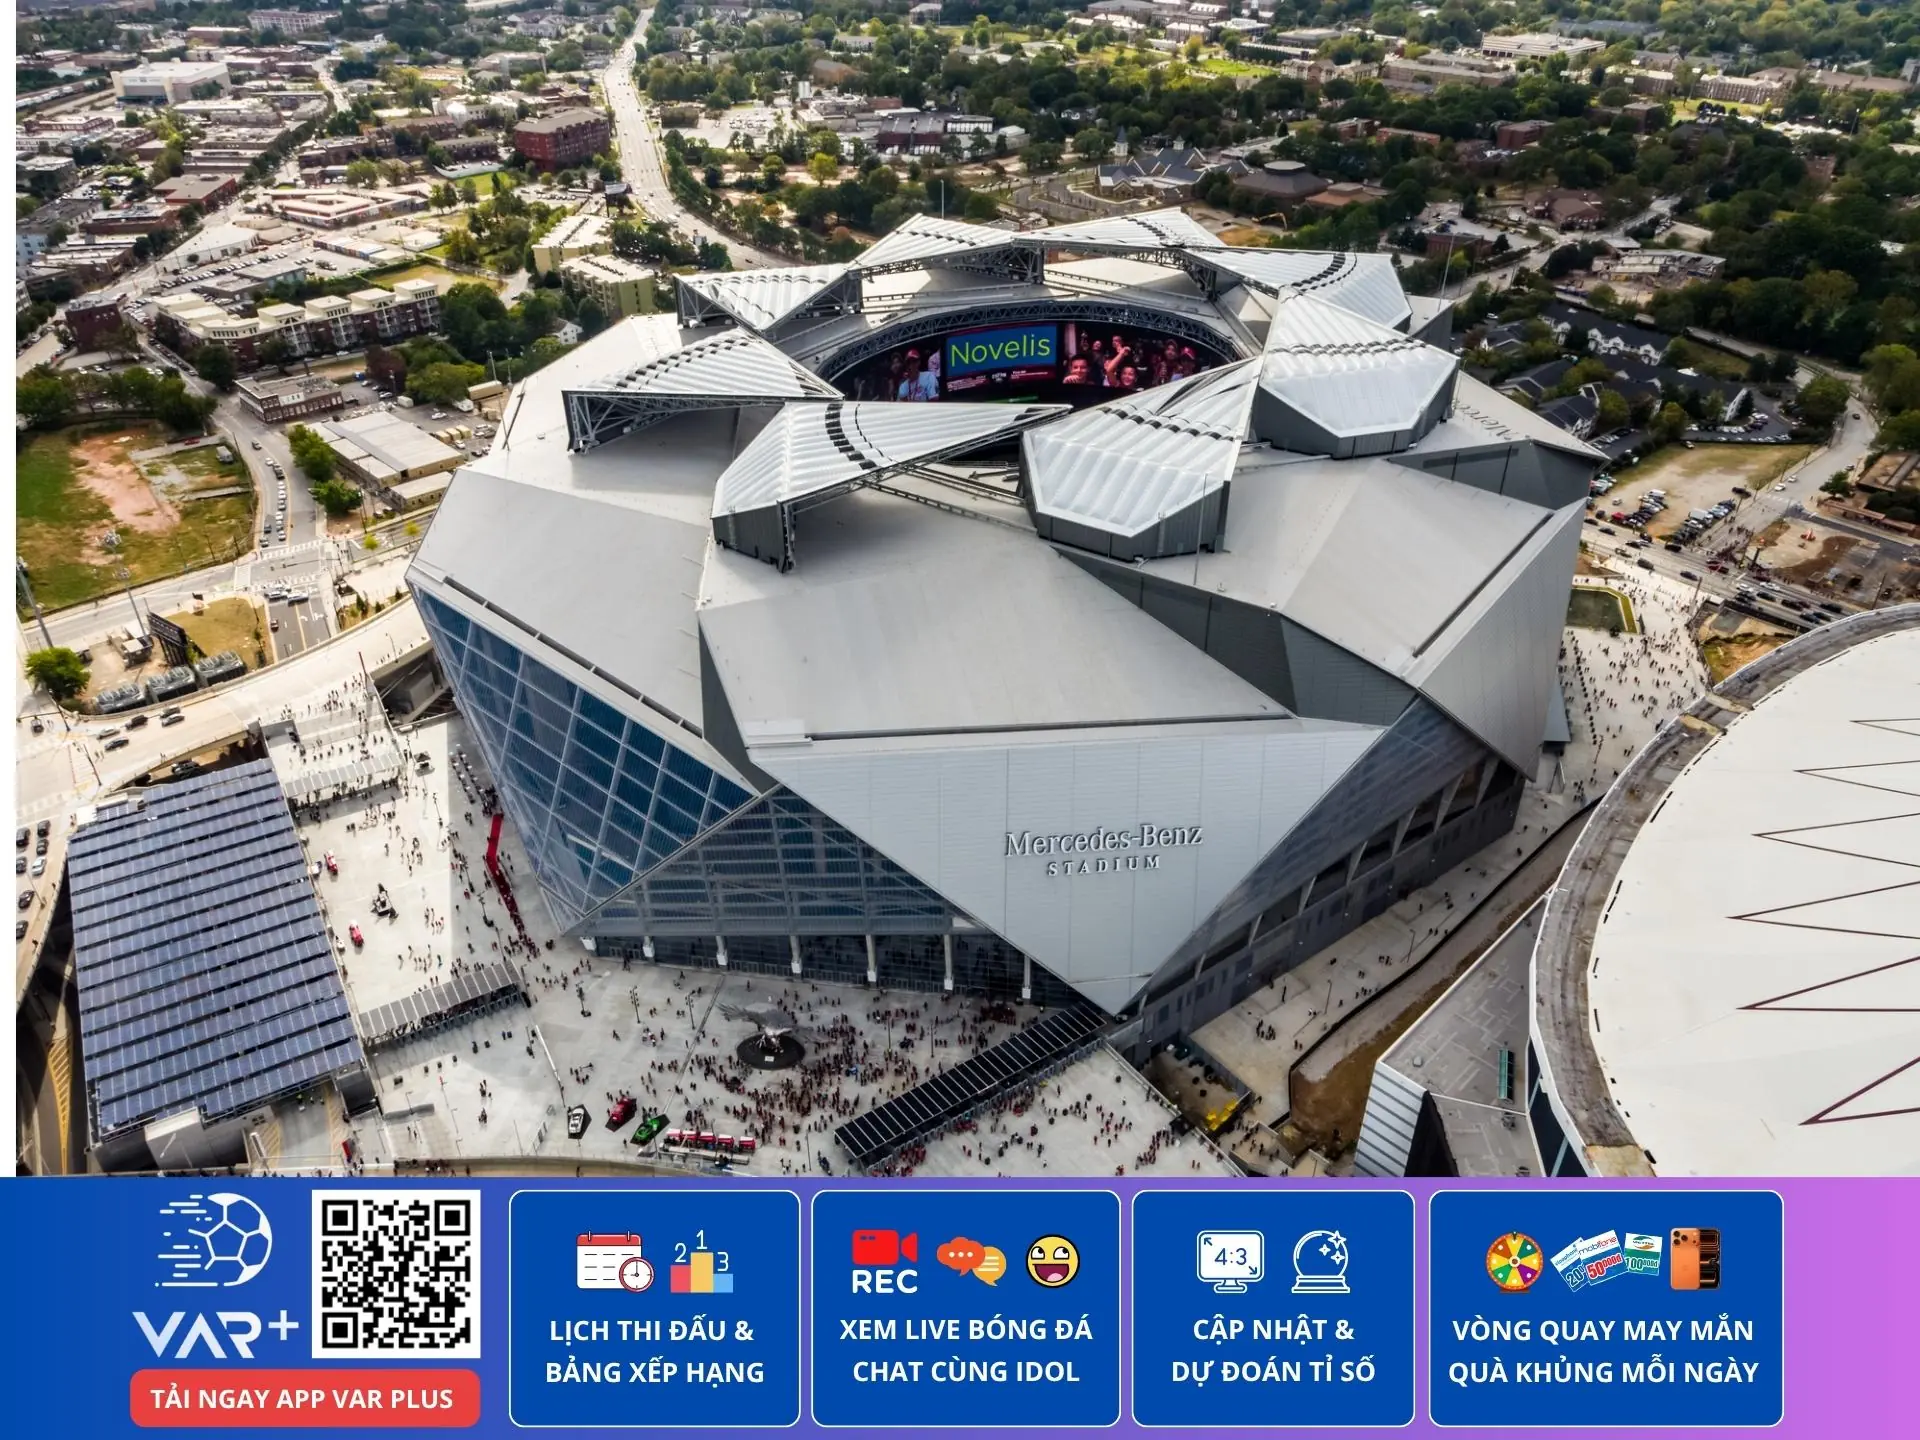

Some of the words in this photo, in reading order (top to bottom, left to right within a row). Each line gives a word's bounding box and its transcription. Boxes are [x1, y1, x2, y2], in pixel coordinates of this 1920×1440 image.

[951, 334, 1050, 367] Novelis
[1005, 823, 1203, 857] Mercedes-Benz
[1048, 855, 1161, 877] STADIUM
